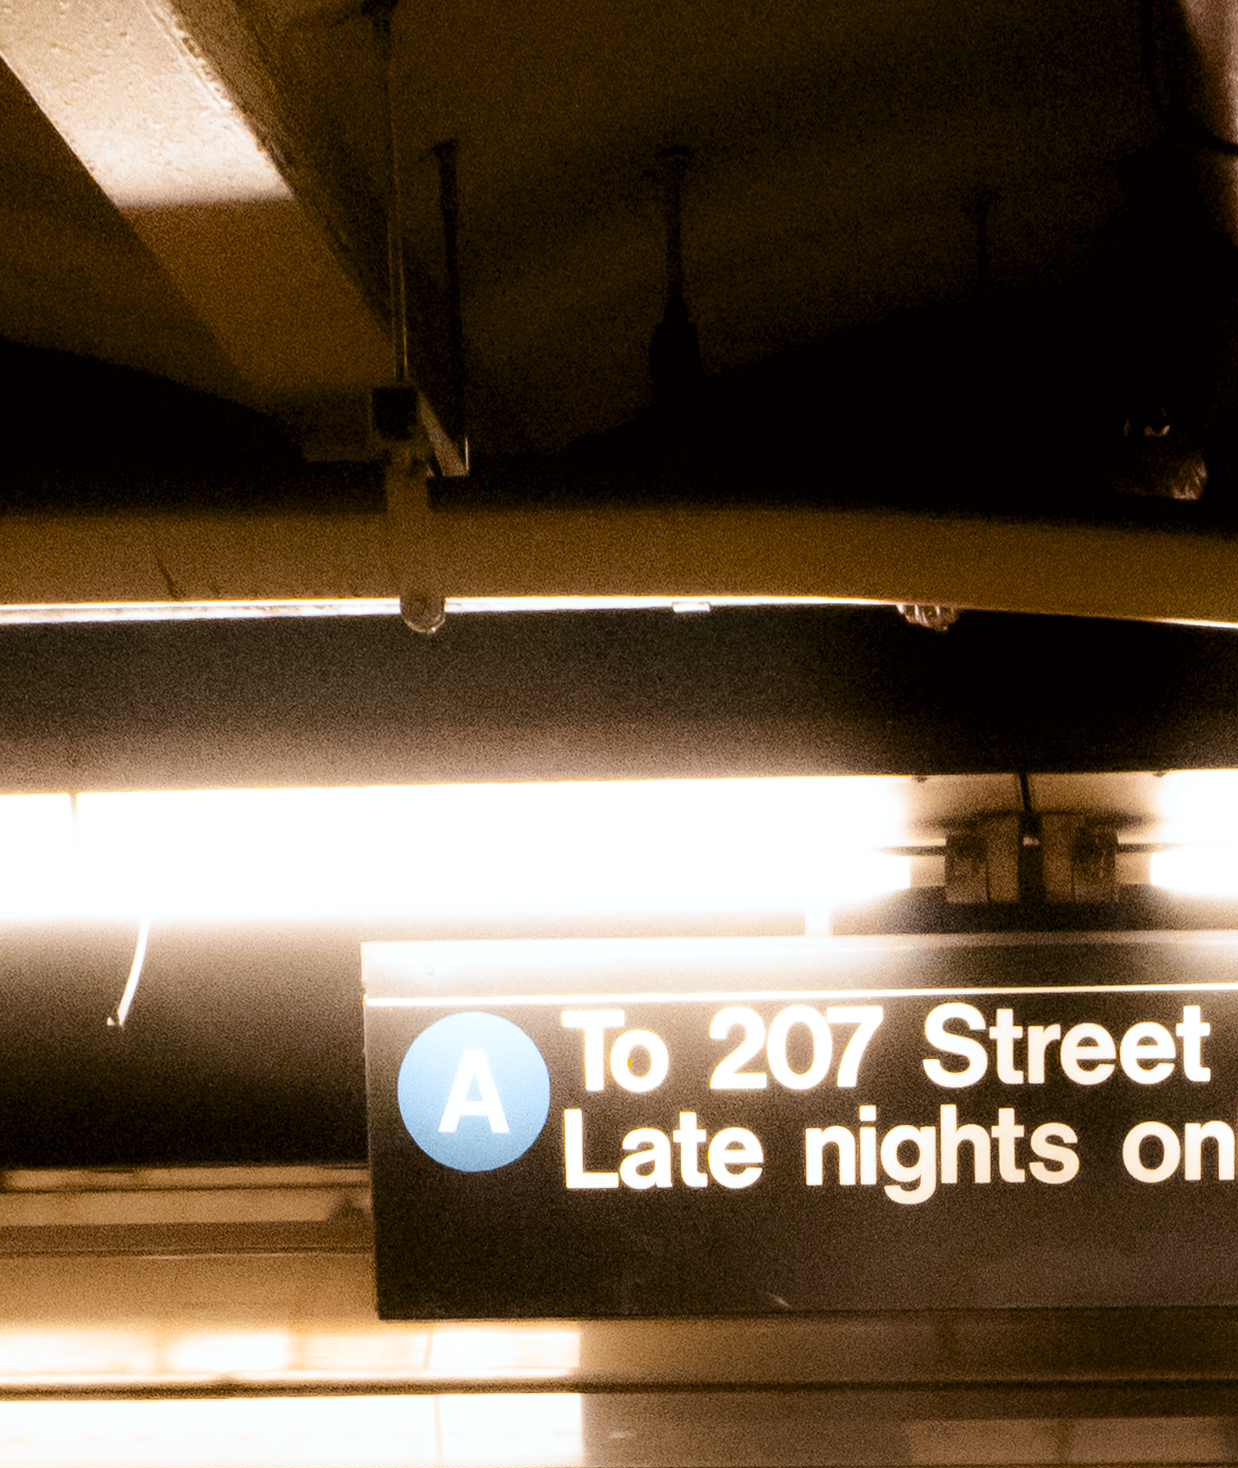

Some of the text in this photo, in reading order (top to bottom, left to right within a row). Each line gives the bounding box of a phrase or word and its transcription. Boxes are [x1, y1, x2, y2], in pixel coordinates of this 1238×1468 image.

[437, 1048, 510, 1135] A
[560, 1003, 1211, 1093] To 207 Street
[562, 1107, 764, 1190] Late
[804, 1104, 1081, 1206] nights
